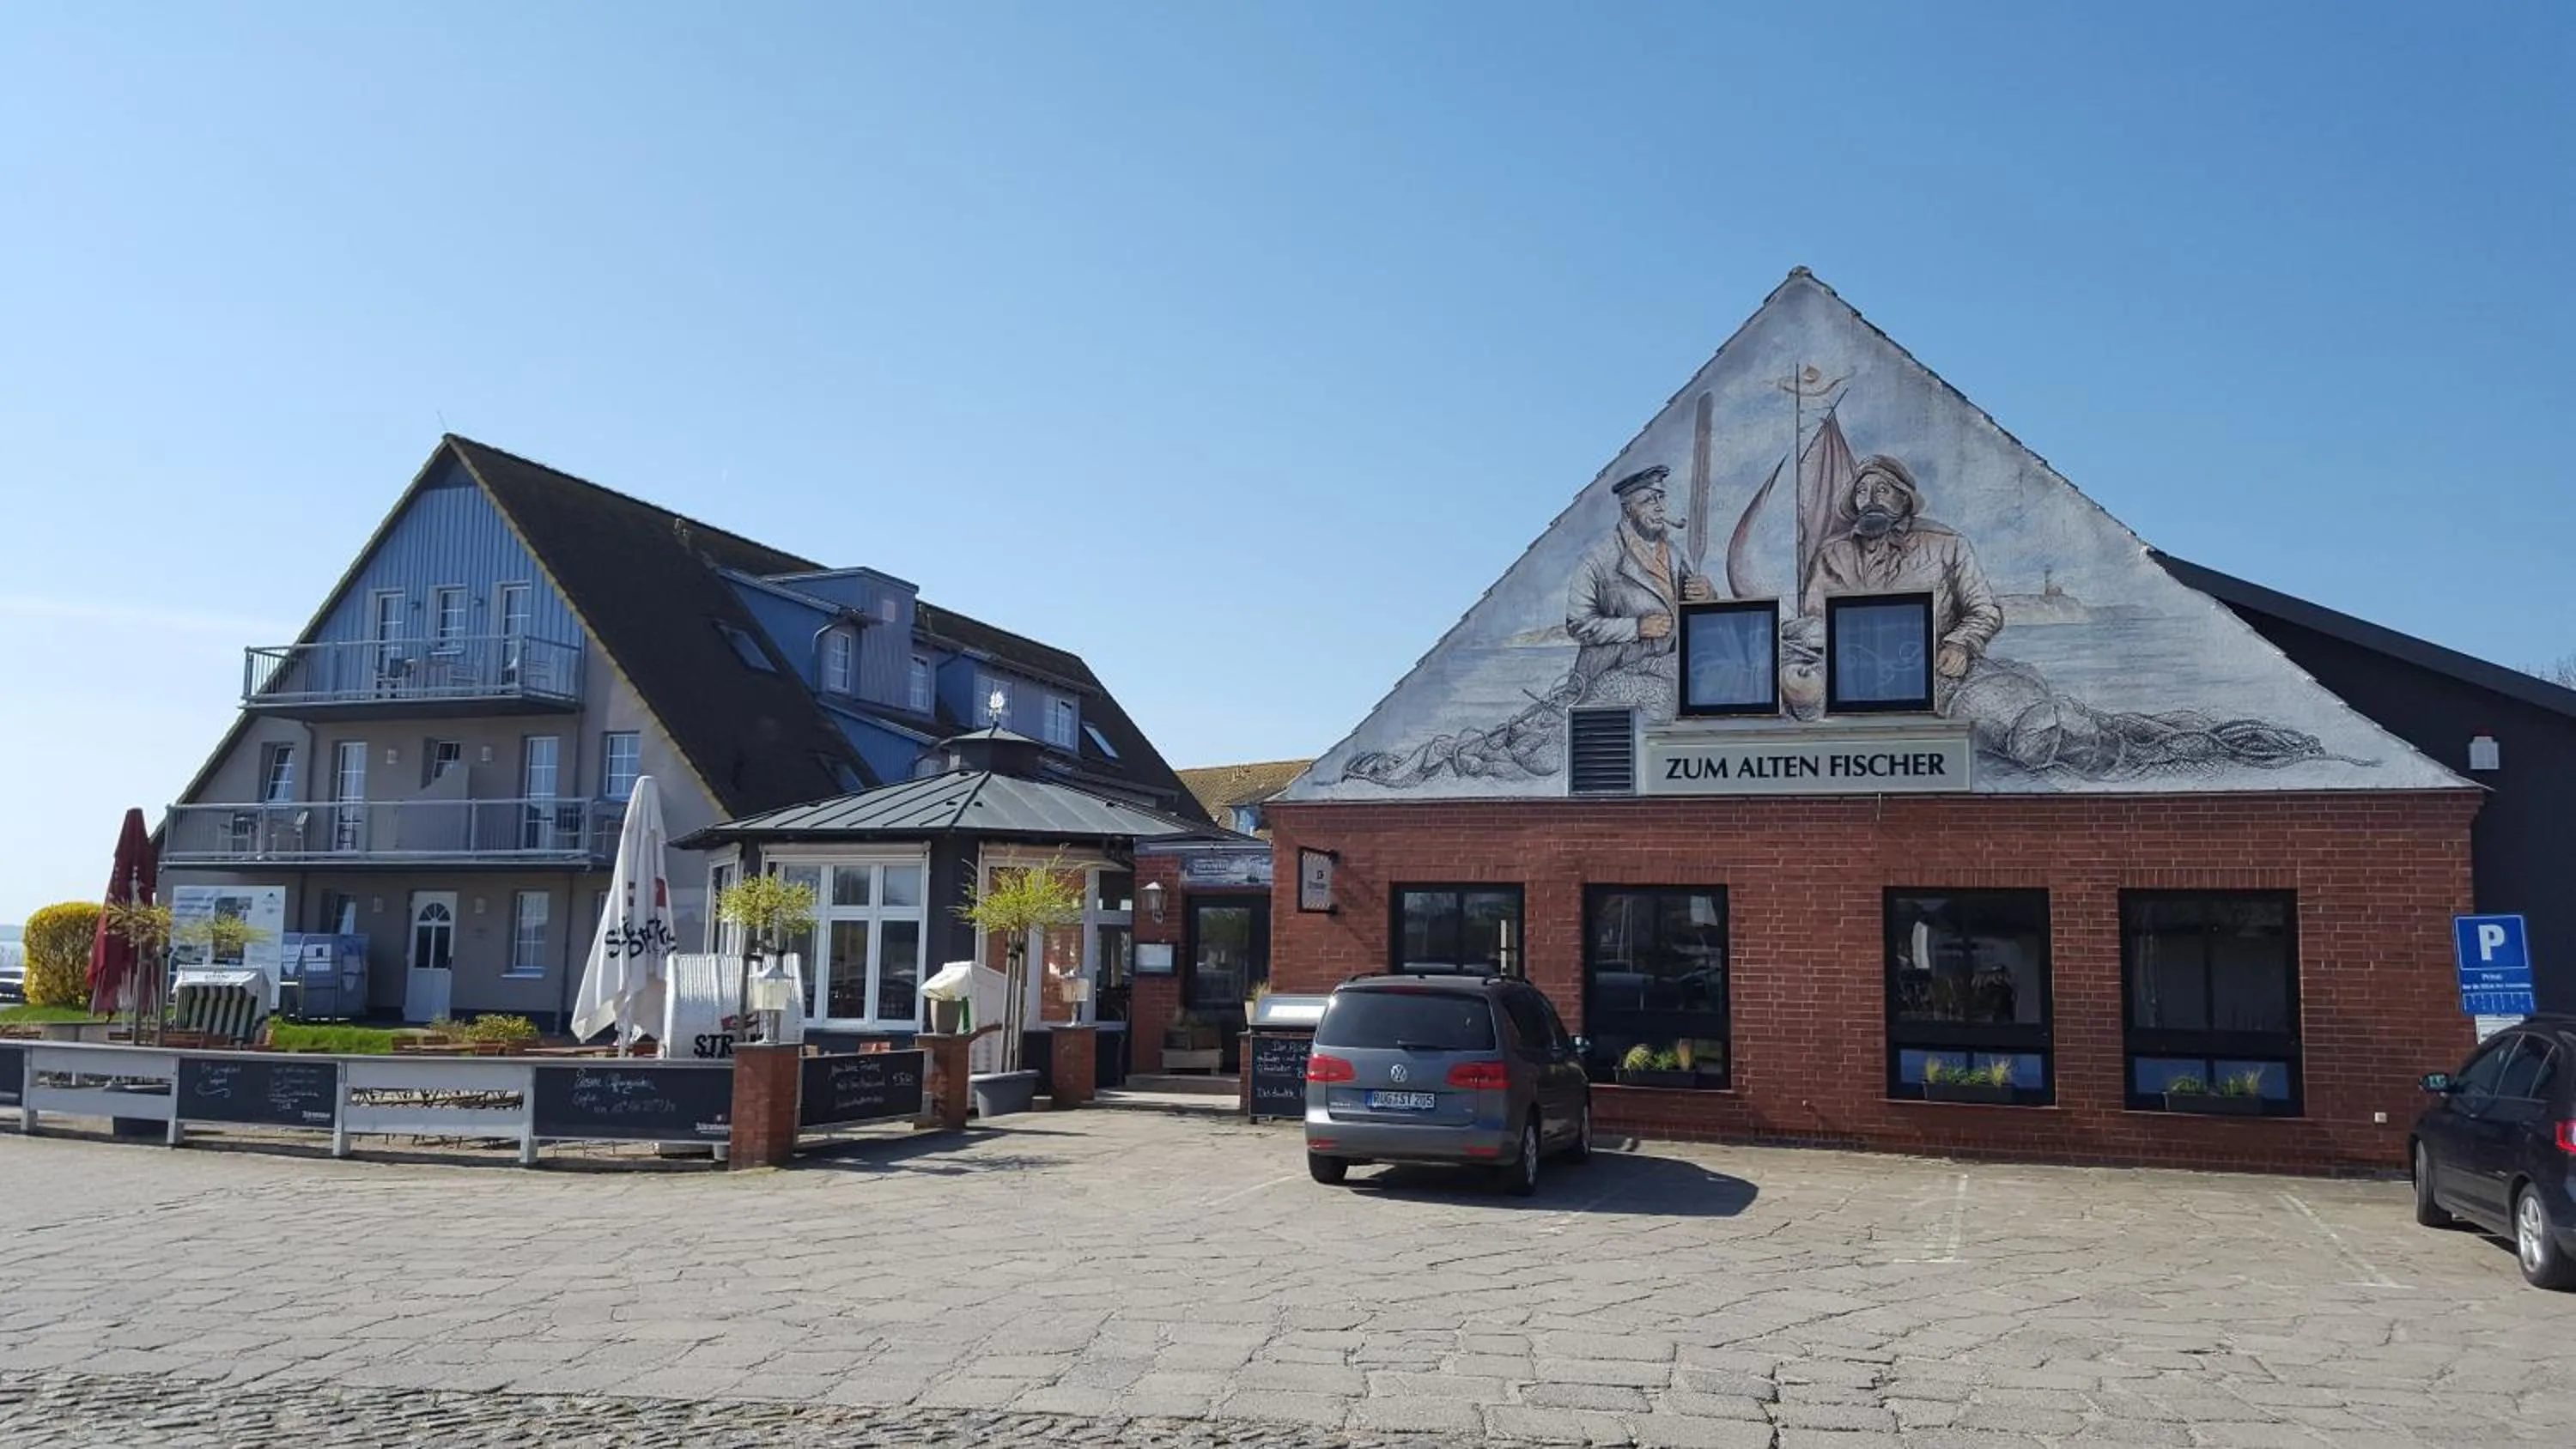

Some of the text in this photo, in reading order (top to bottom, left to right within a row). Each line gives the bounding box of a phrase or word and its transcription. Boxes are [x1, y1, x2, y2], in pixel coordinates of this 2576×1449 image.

[1666, 753, 1946, 779] ZUM ALTEN FISCHER
[2478, 925, 2505, 961] P
